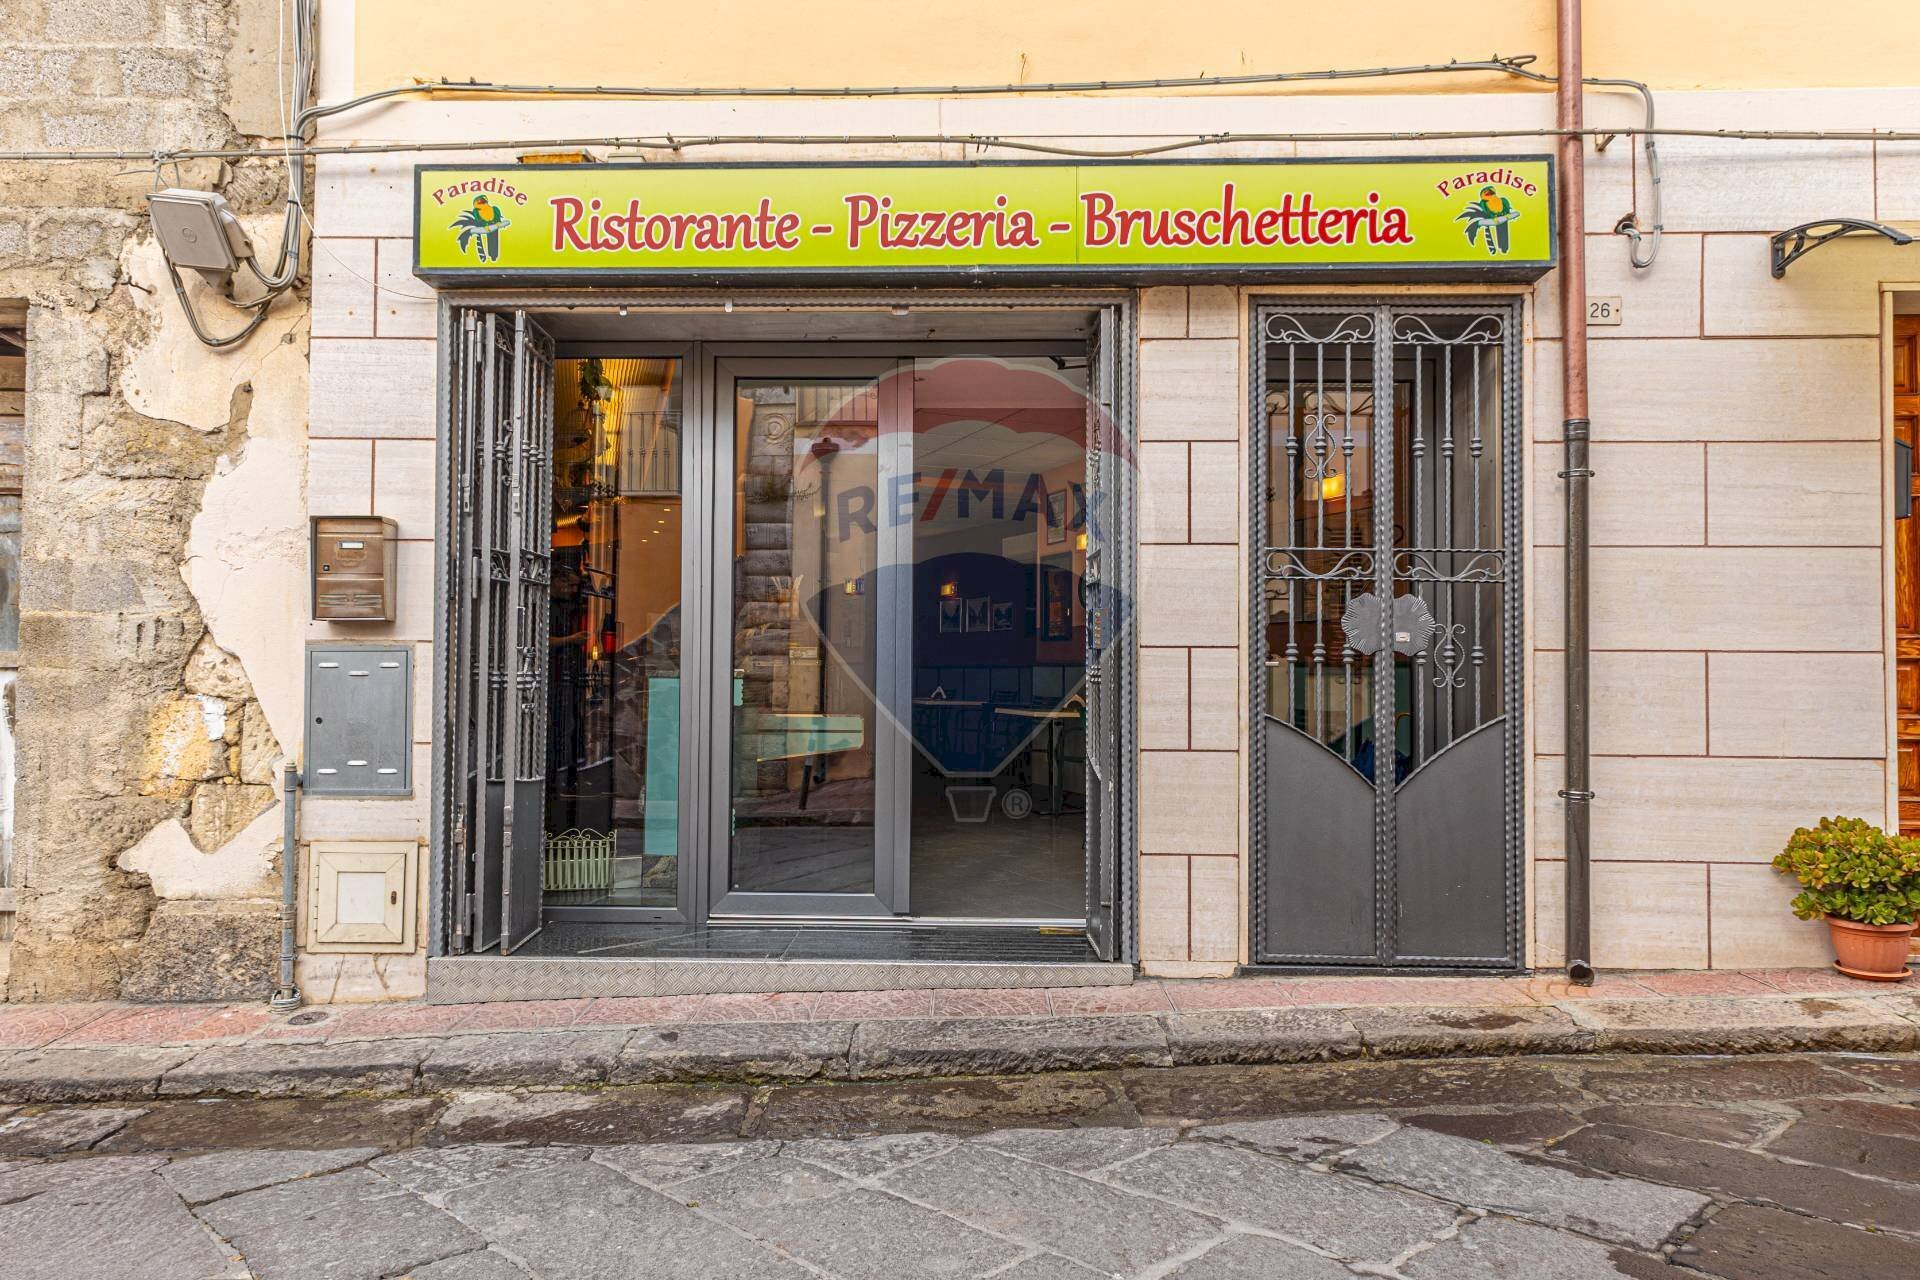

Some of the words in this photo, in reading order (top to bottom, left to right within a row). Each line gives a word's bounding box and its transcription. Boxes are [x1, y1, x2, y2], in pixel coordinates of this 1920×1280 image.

[432, 177, 528, 206] Paradise
[1436, 168, 1538, 197] Paradise
[549, 196, 800, 251] Ristorante
[844, 194, 1040, 249] Pizzeria
[1080, 182, 1415, 247] Bruschetteria
[1590, 302, 1610, 318] 26
